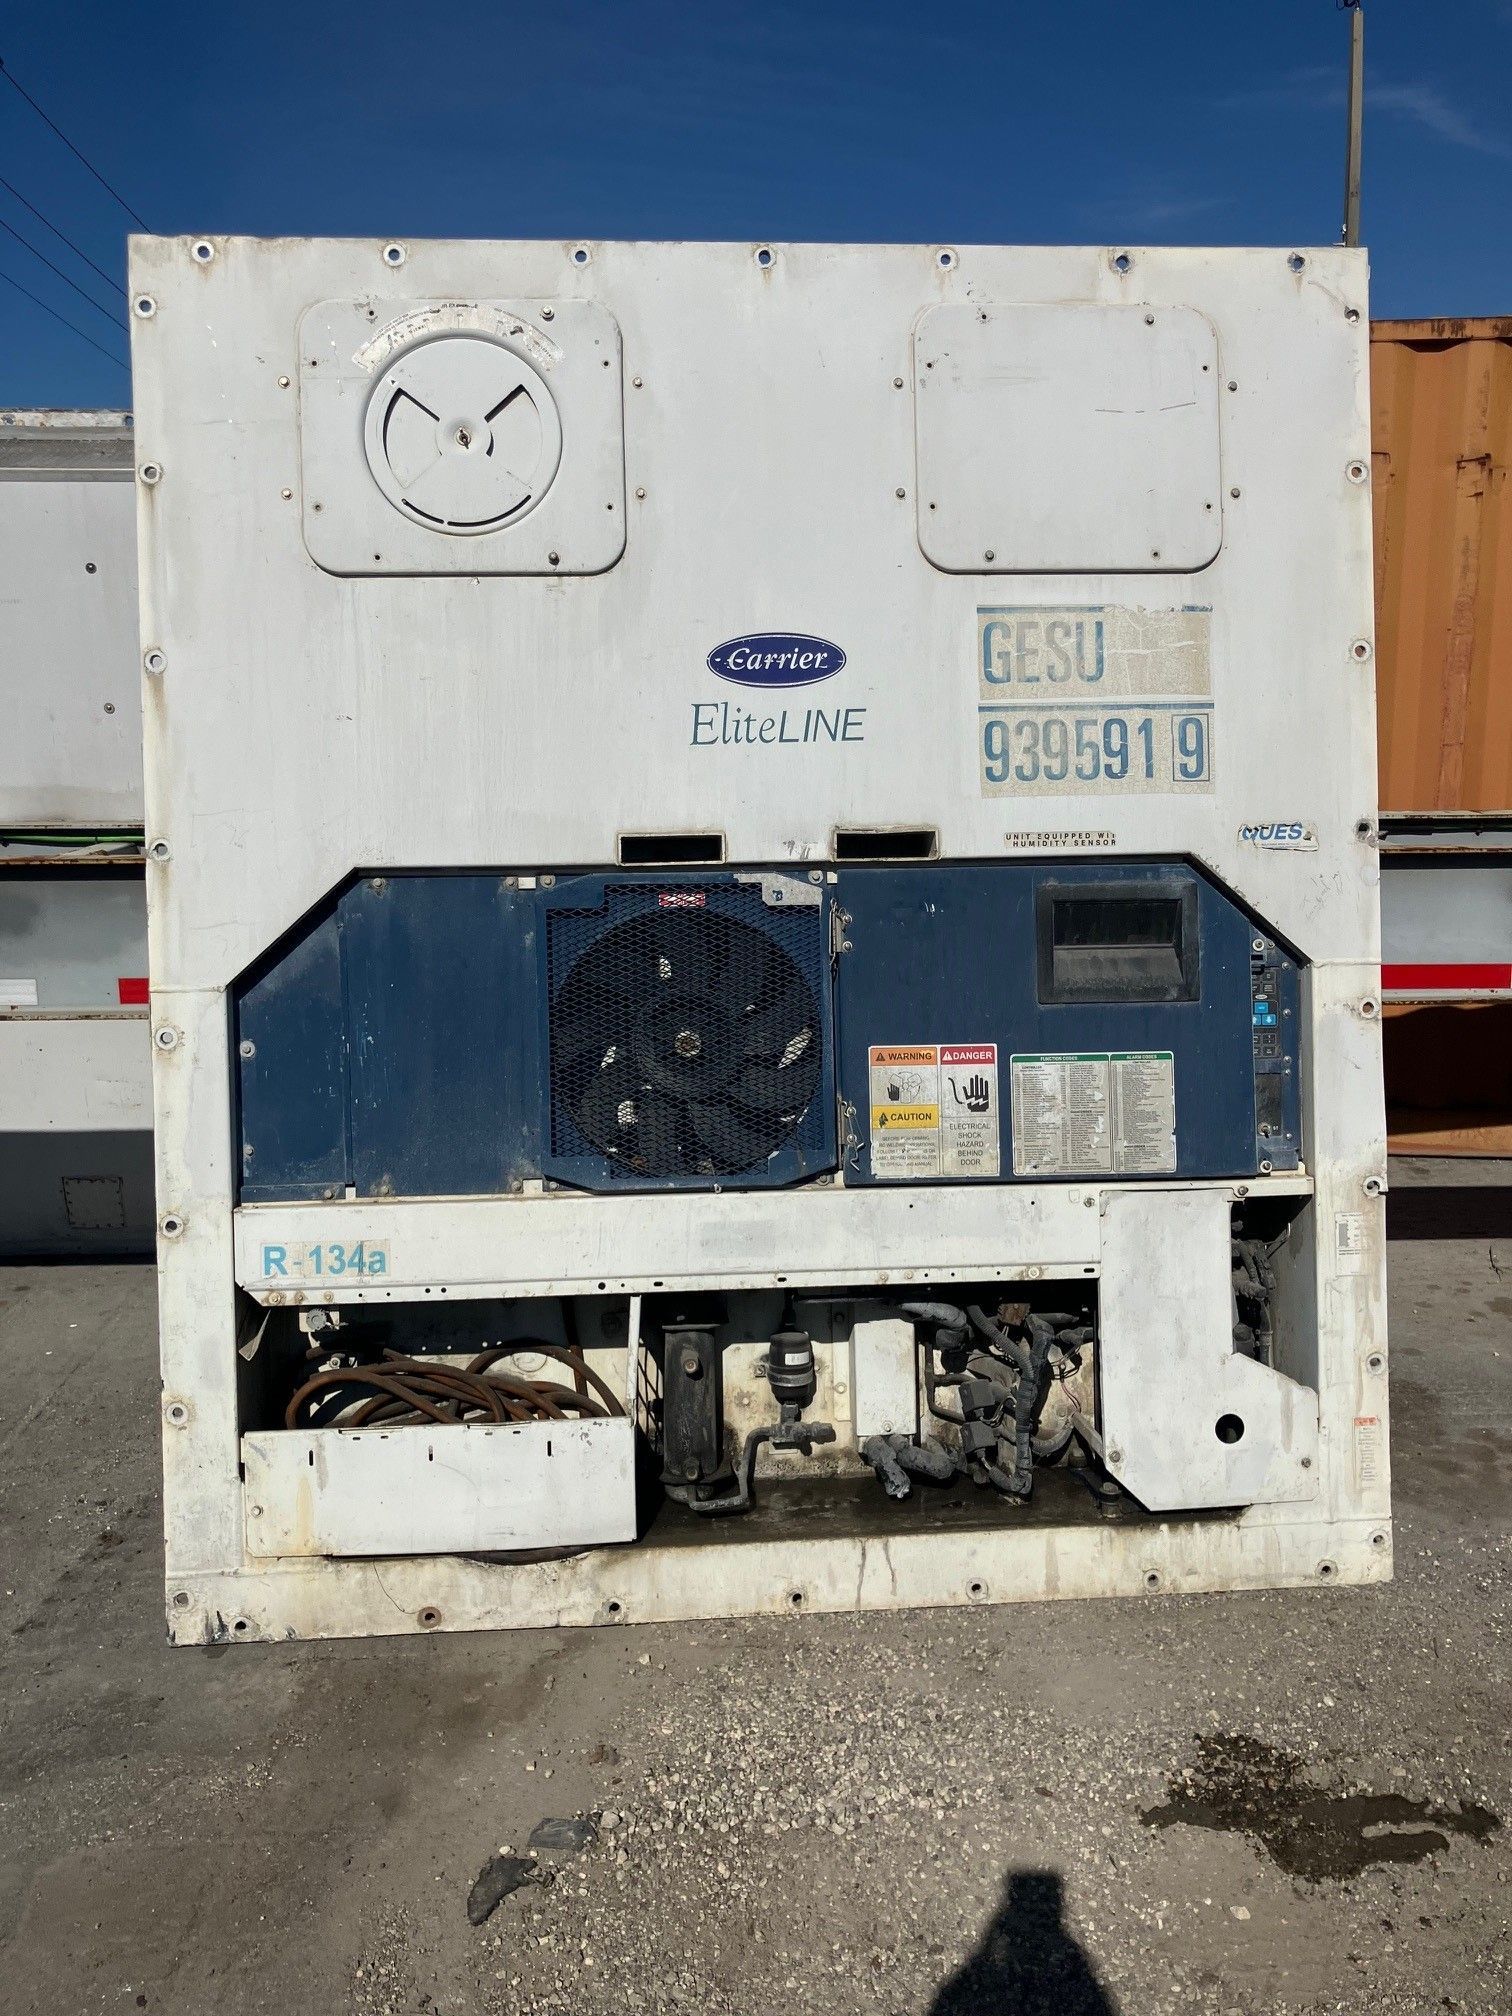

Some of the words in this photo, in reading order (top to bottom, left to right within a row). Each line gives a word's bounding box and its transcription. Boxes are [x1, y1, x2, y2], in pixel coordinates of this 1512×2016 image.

[982, 620, 1105, 684] GESU
[727, 648, 828, 670] Carrier
[690, 701, 867, 746] EliteLINE
[984, 717, 1154, 783] 939591
[1178, 717, 1204, 780] 9
[1005, 833, 1031, 841] UNIT
[1037, 832, 1091, 840] EQUIPPED
[1073, 839, 1116, 847] SENSOR
[888, 1052, 932, 1061] WARNING
[952, 1051, 993, 1060] DANGER
[890, 1113, 932, 1121] CAUTION
[949, 1123, 991, 1131] ELECTRICAL
[264, 1244, 387, 1276] R-134a
